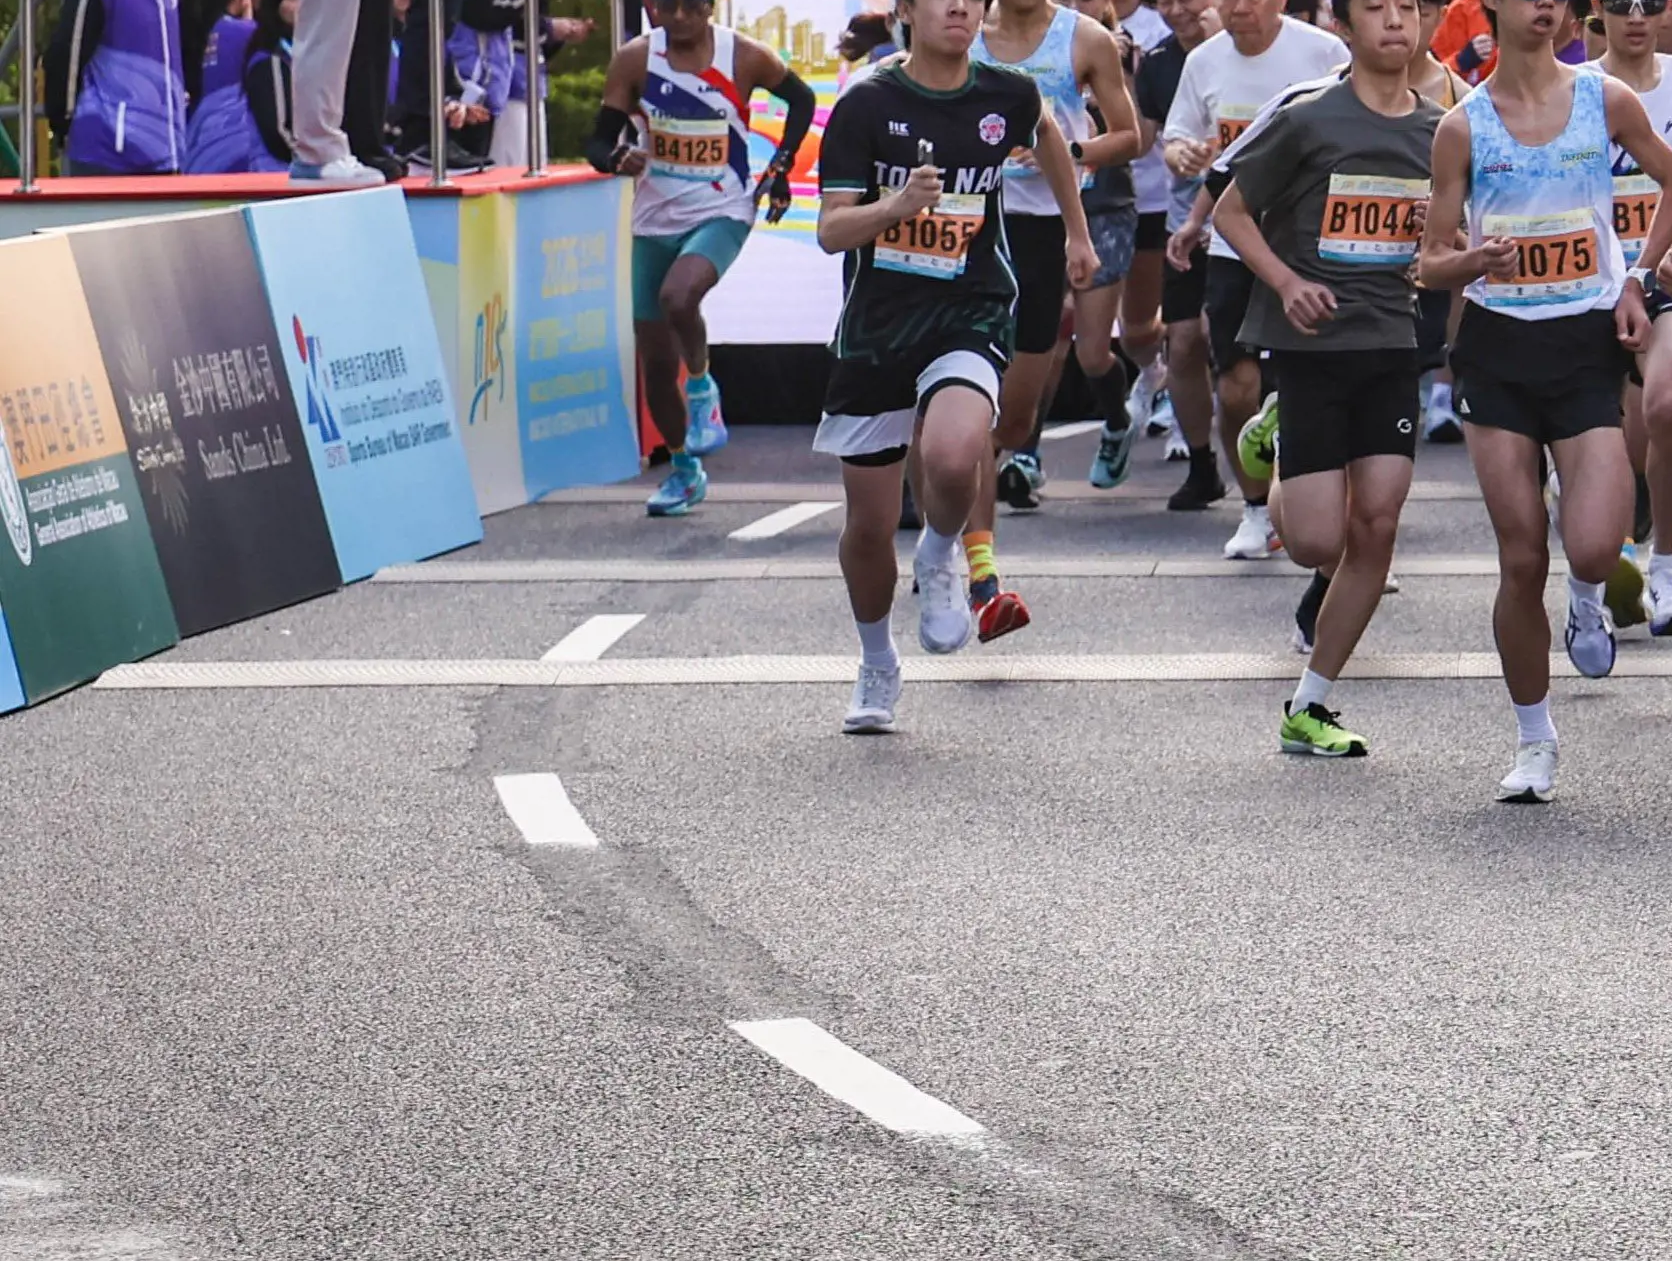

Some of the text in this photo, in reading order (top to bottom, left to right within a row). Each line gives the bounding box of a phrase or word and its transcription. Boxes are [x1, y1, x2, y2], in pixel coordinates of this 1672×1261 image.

[654, 135, 723, 162] B4125
[1329, 201, 1416, 236] B1044
[1518, 237, 1592, 278] 1075
